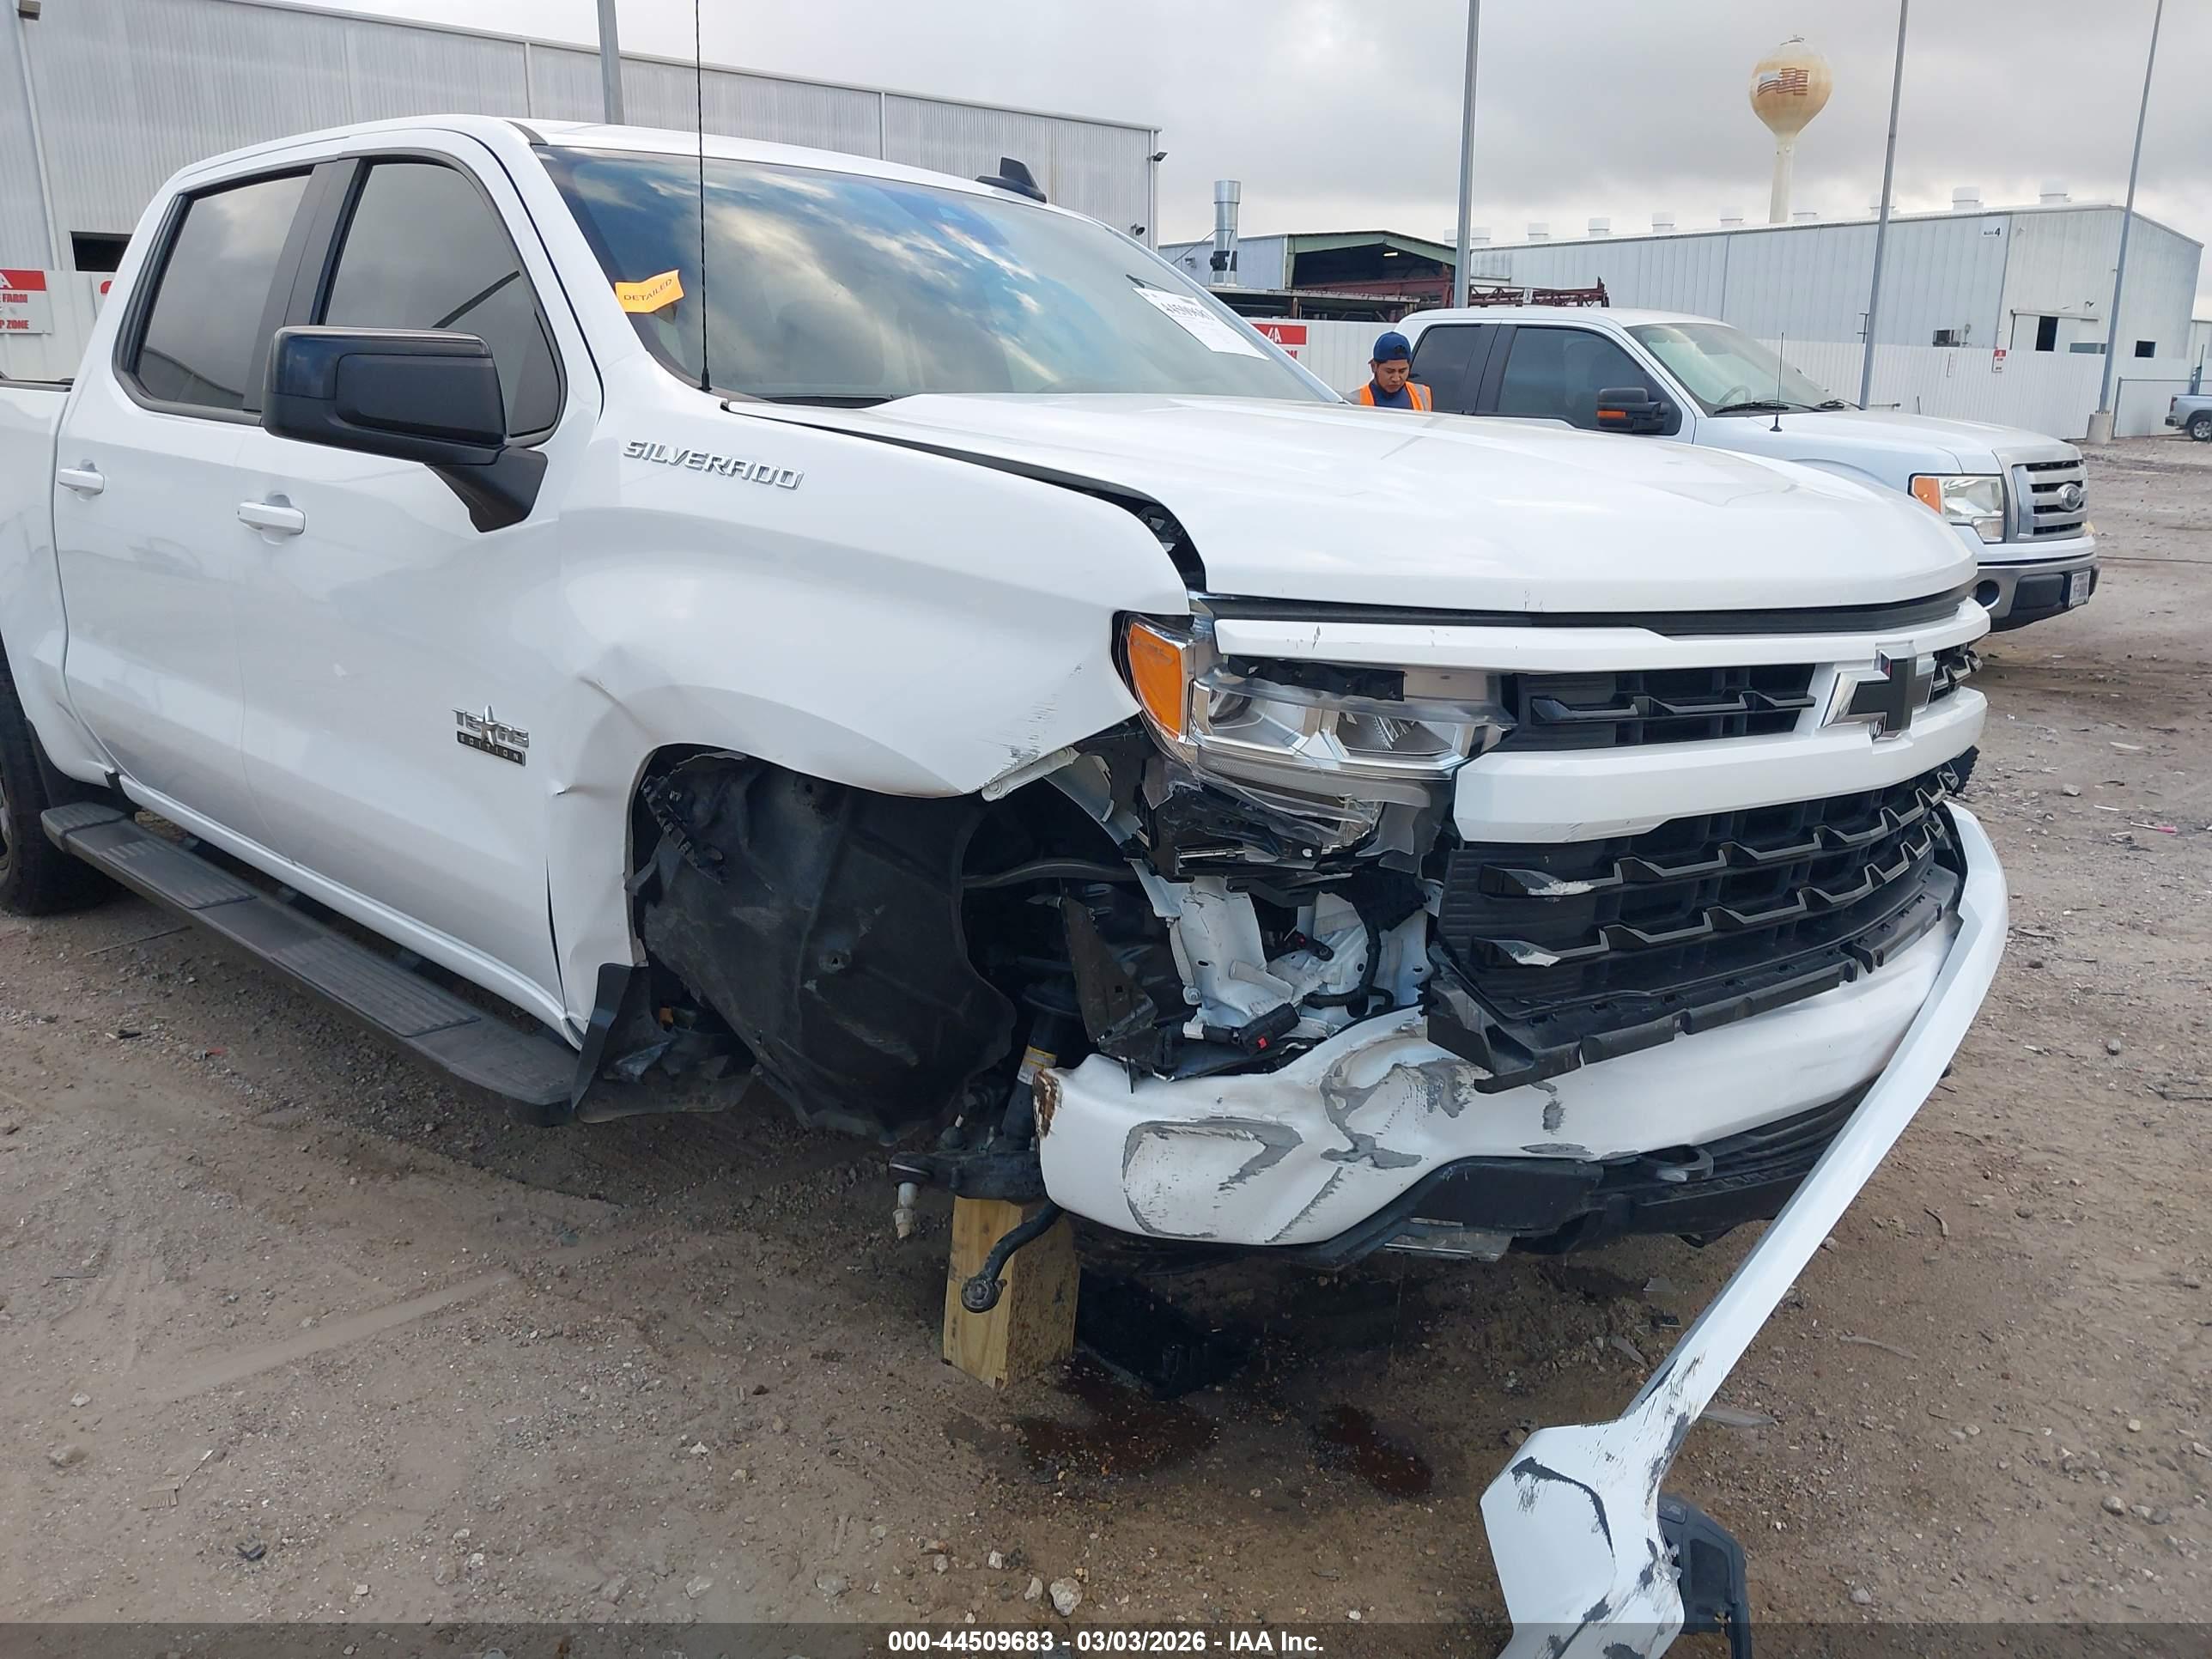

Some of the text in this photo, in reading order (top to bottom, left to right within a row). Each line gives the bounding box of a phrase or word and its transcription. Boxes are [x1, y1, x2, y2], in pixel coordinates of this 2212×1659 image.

[623, 278, 672, 301] DETAILED
[6, 319, 29, 329] ZONE
[623, 440, 805, 489] SILVERADO
[459, 733, 520, 762] EDITION
